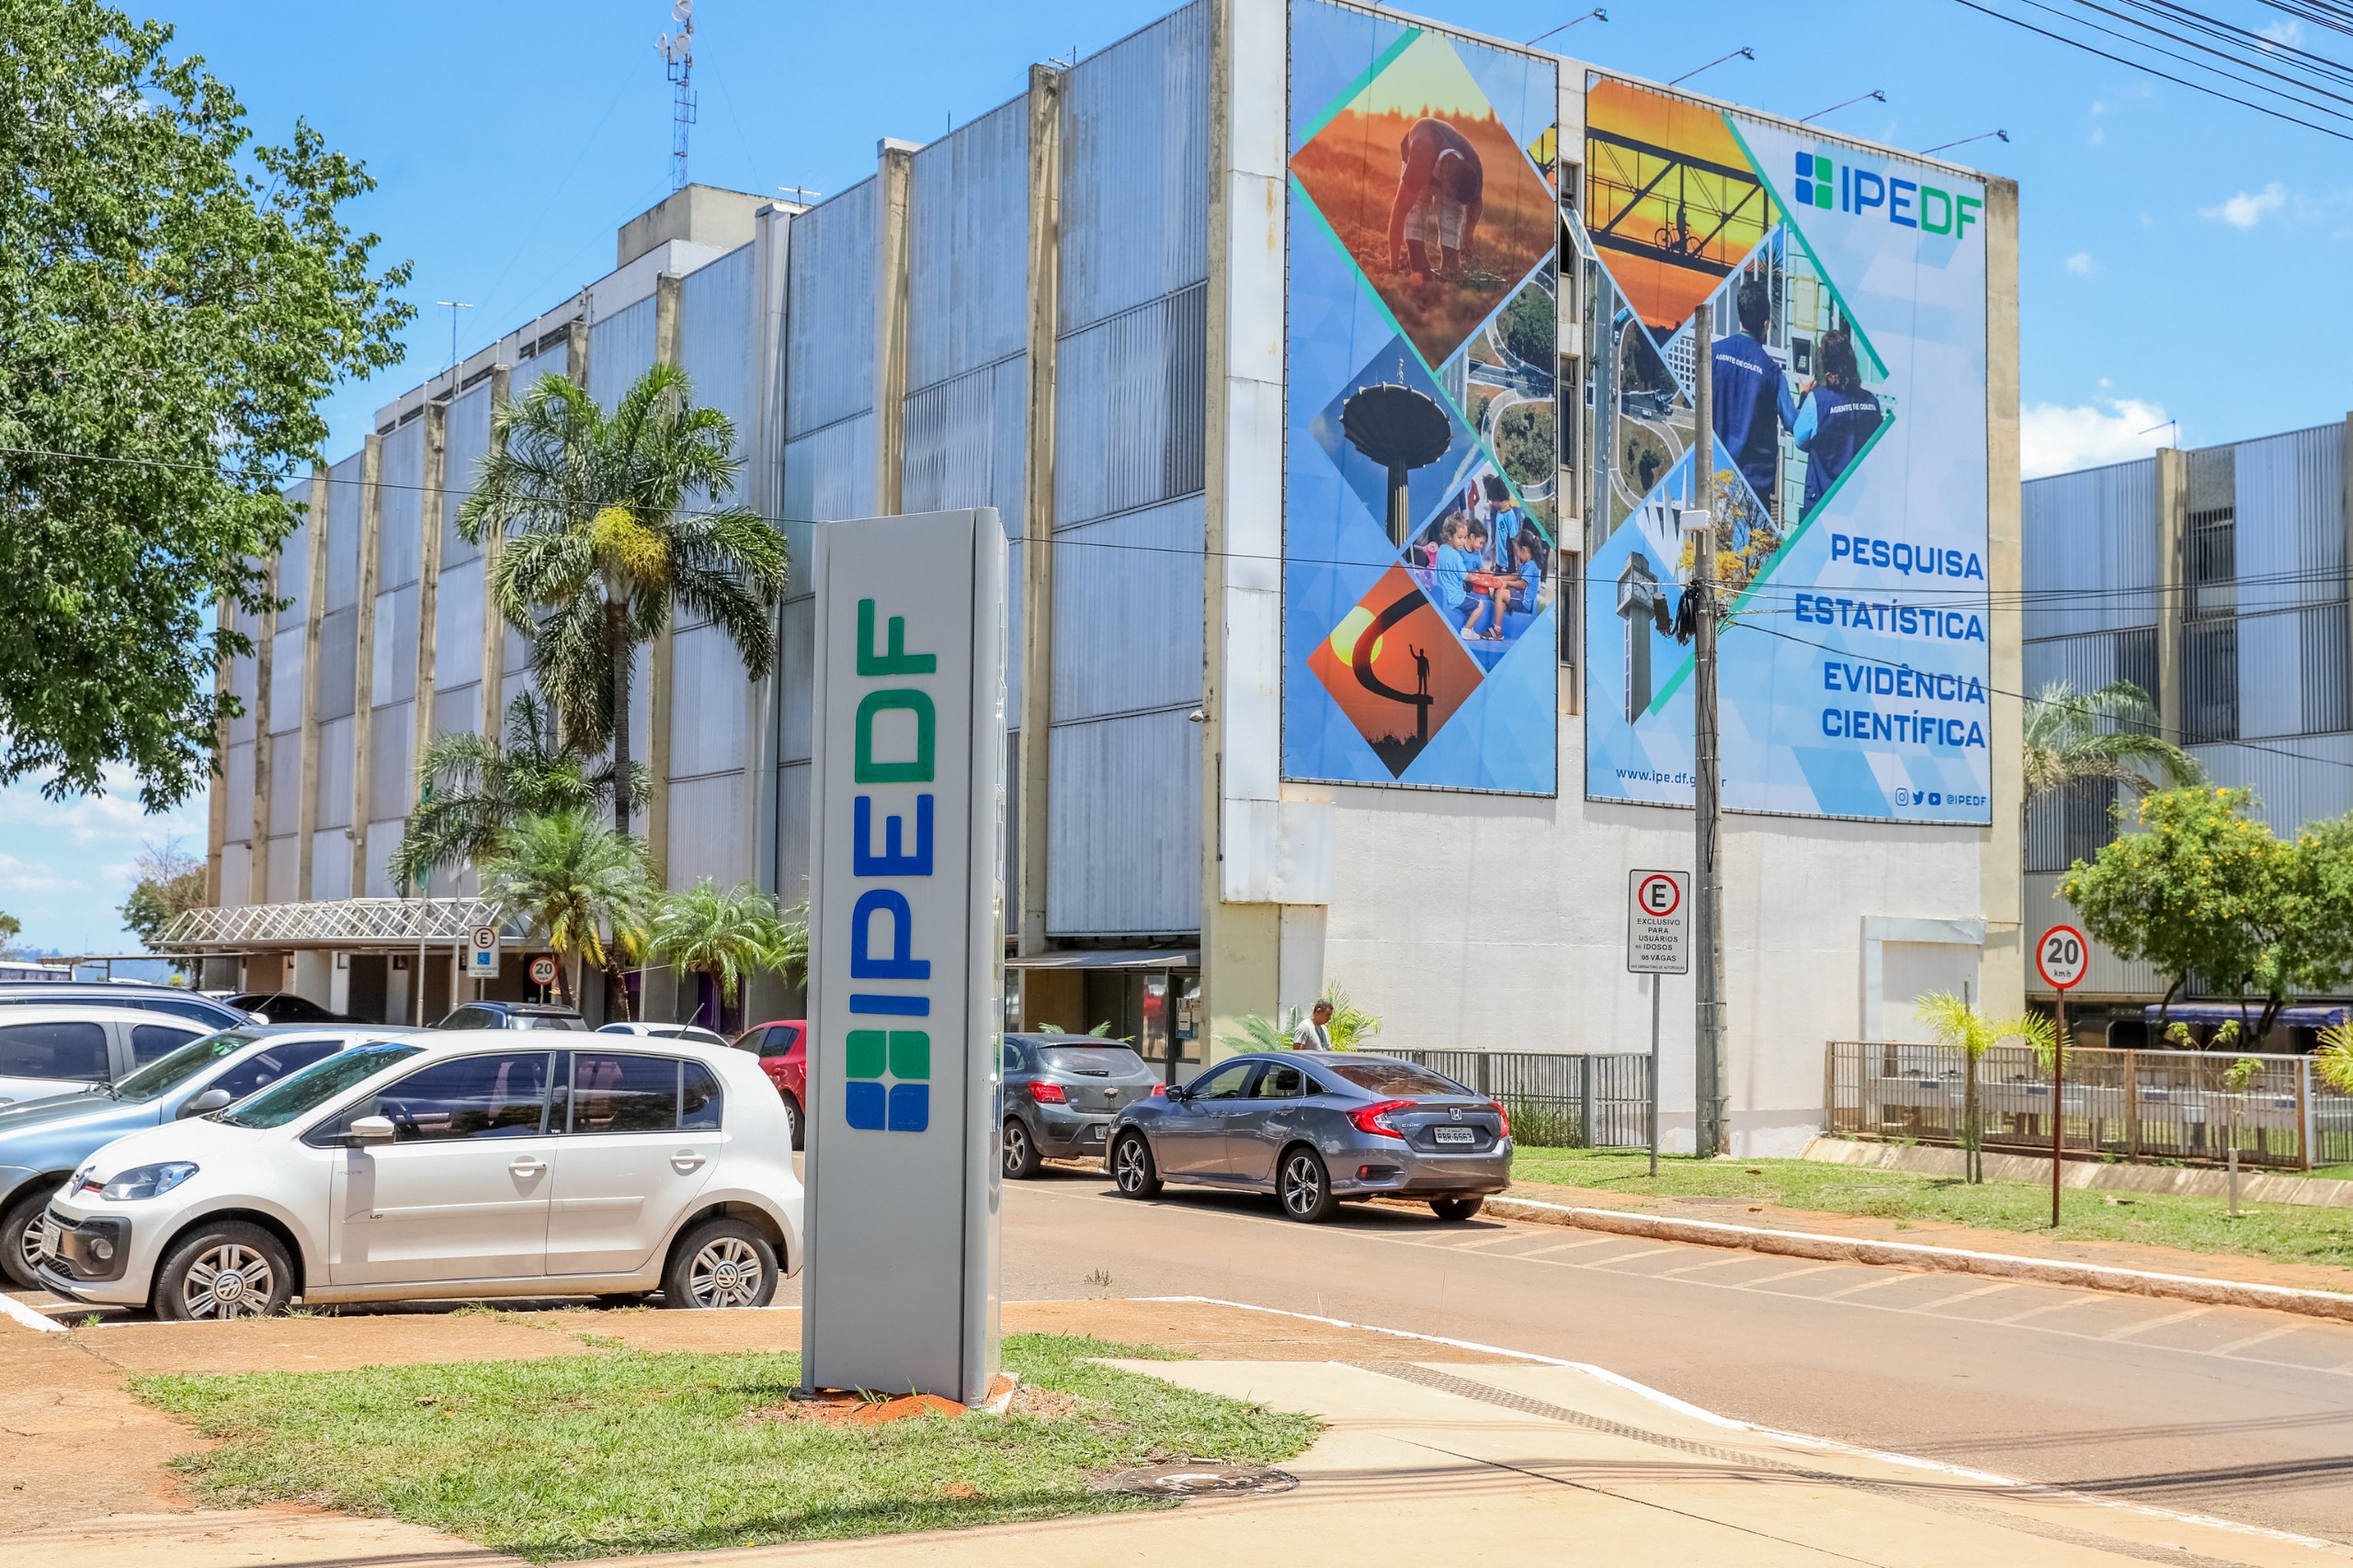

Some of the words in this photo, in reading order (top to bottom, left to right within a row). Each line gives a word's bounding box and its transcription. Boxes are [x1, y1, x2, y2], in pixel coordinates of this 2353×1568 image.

[1842, 165, 1982, 240] IPEDF
[1715, 353, 1735, 364] AGENTE
[1735, 358, 1744, 367] DE
[1744, 362, 1763, 374] COLETA
[1830, 403, 1852, 414] AGENTE
[1853, 403, 1859, 411] DE
[1859, 402, 1877, 411] COLETA
[1832, 533, 1984, 581] PESQUISA
[1795, 593, 1984, 642] ESTATÍSTICA
[1824, 662, 1985, 704] EVIDÊNCIA
[1822, 708, 1985, 748] CIENTÍFICA
[1616, 768, 1726, 788] www.ipe.df.gr
[849, 598, 937, 1017] IPEDF
[1947, 794, 1986, 806] @IPEDF
[1652, 884, 1666, 907] E
[480, 932, 488, 945] E
[1639, 935, 1678, 943] USUÁRIOS
[2047, 937, 2079, 965] 20
[535, 962, 552, 974] 20
[2053, 970, 2071, 978] km/h
